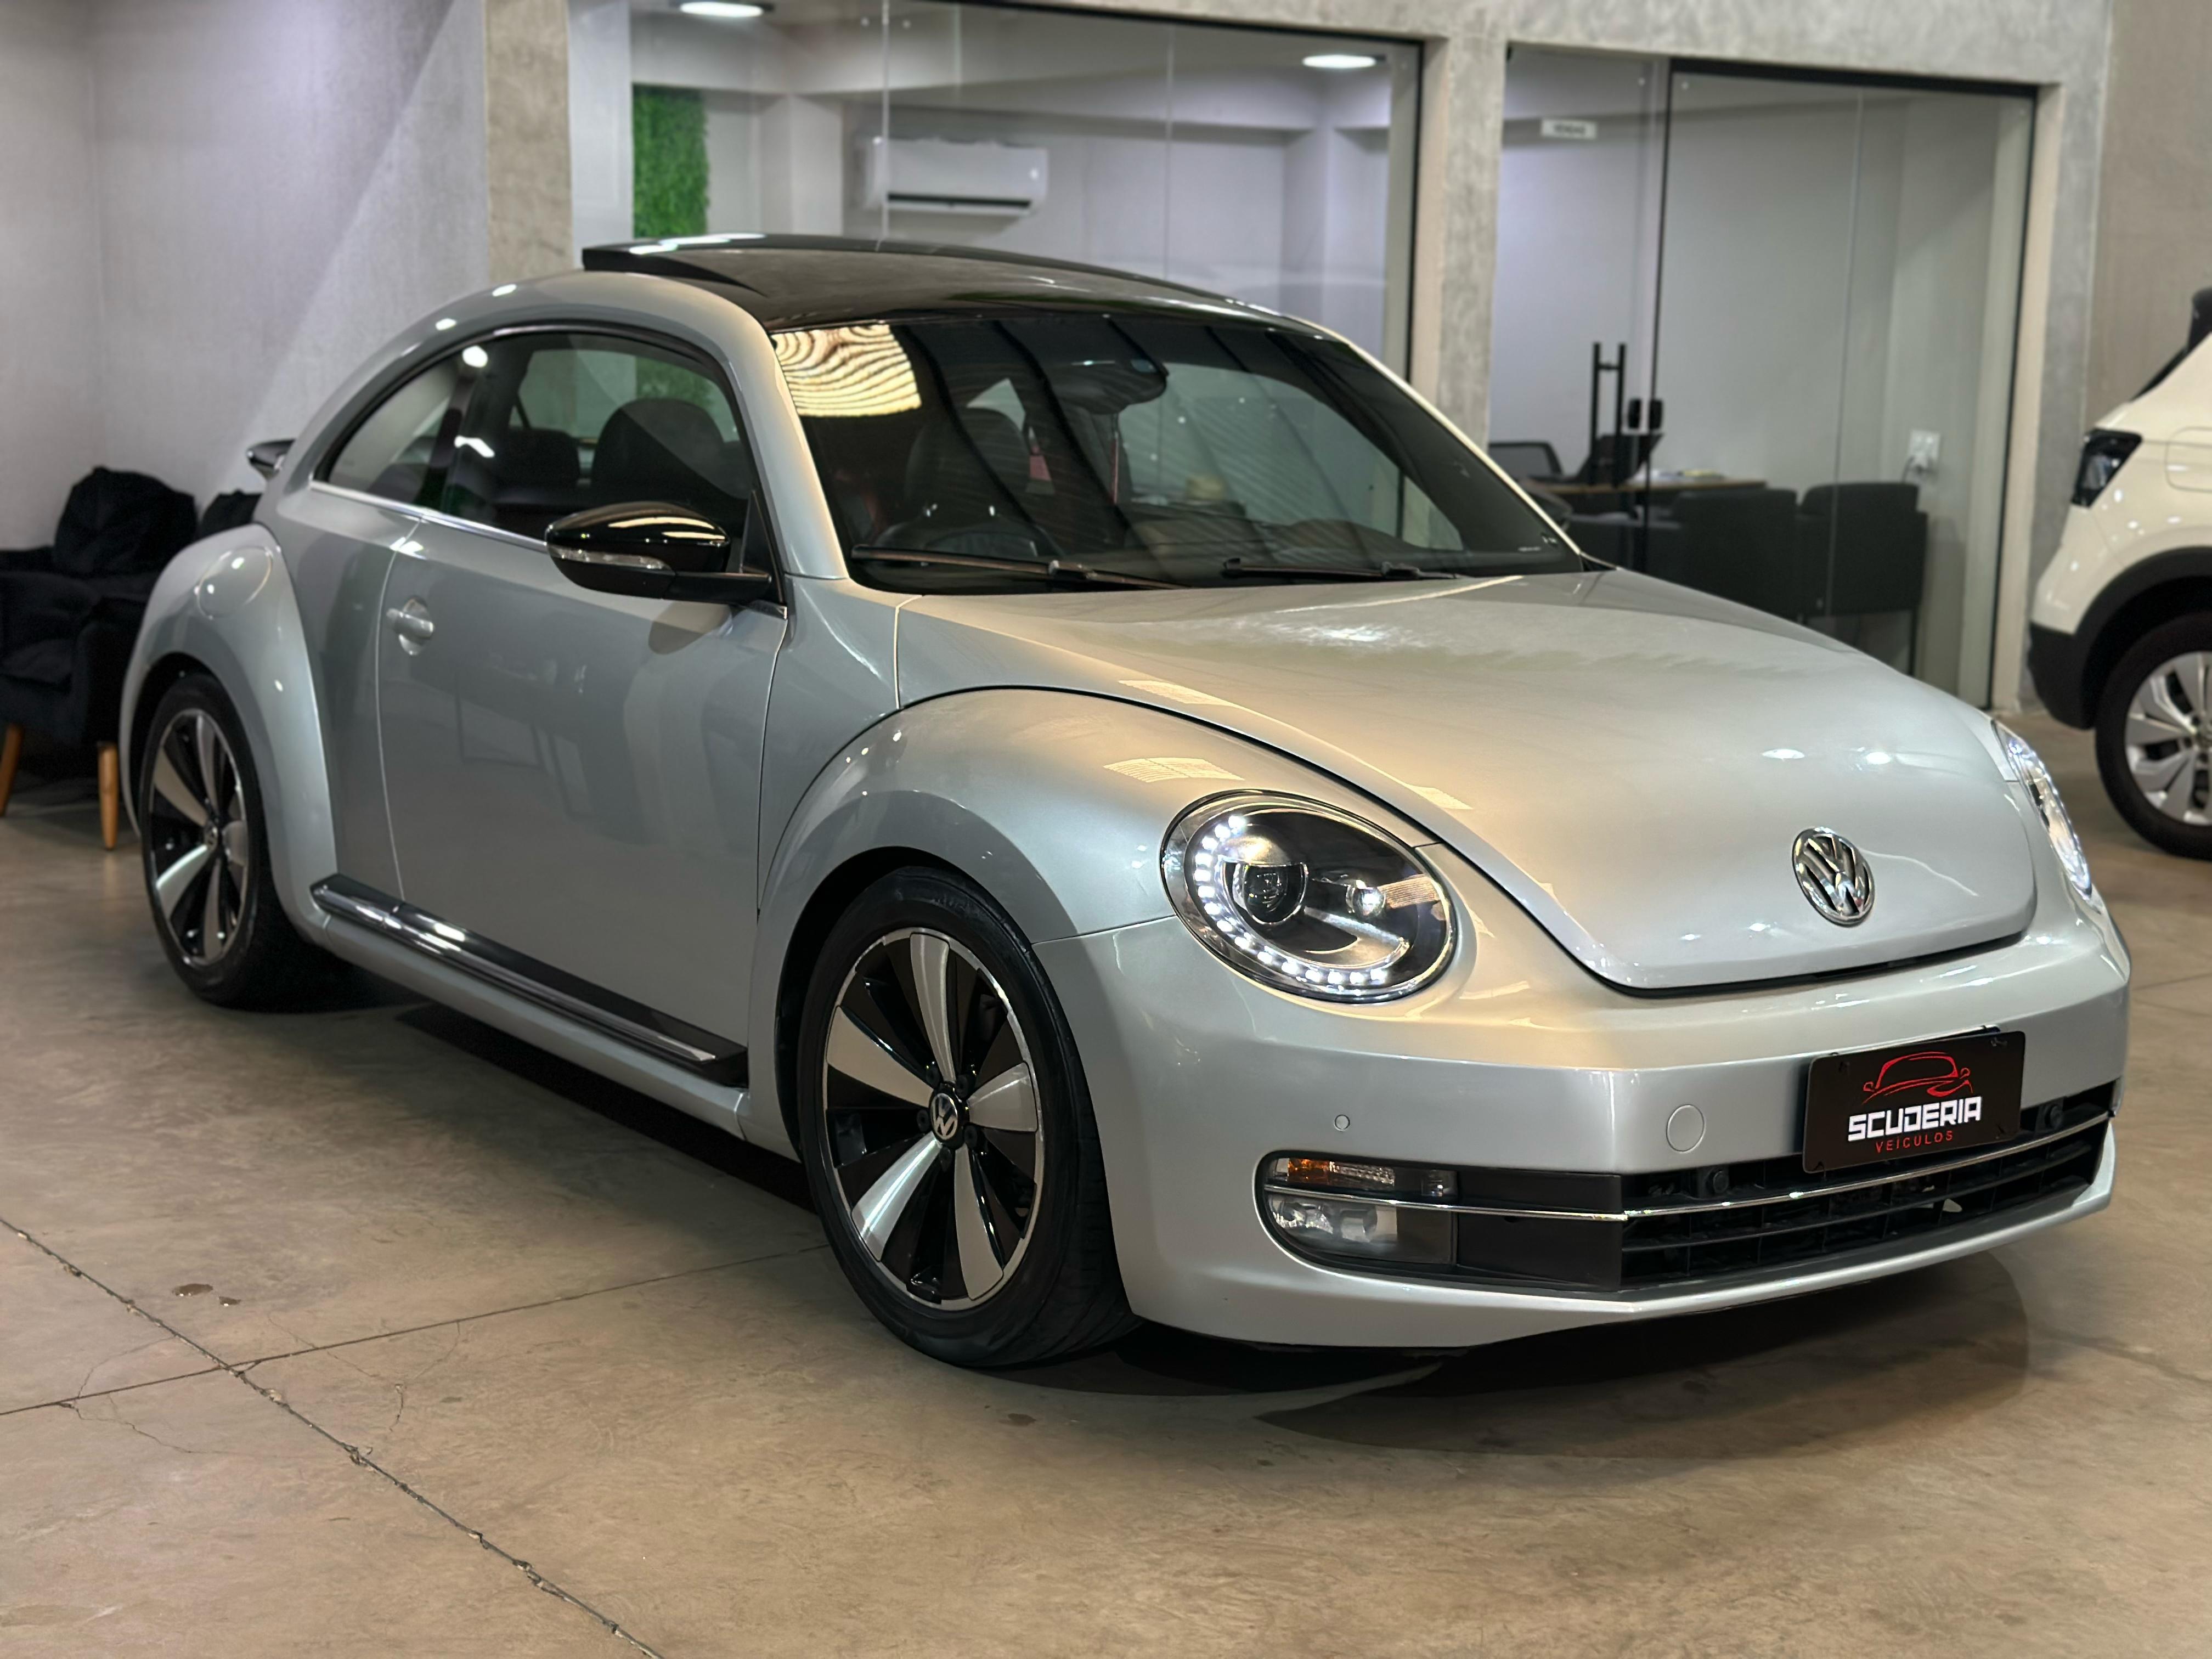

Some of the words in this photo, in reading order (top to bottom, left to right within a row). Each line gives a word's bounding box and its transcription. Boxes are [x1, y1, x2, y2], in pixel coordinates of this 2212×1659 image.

[1793, 828, 1874, 926] VW
[931, 1093, 958, 1140] VW
[1847, 1096, 1982, 1142] SCUDERIA
